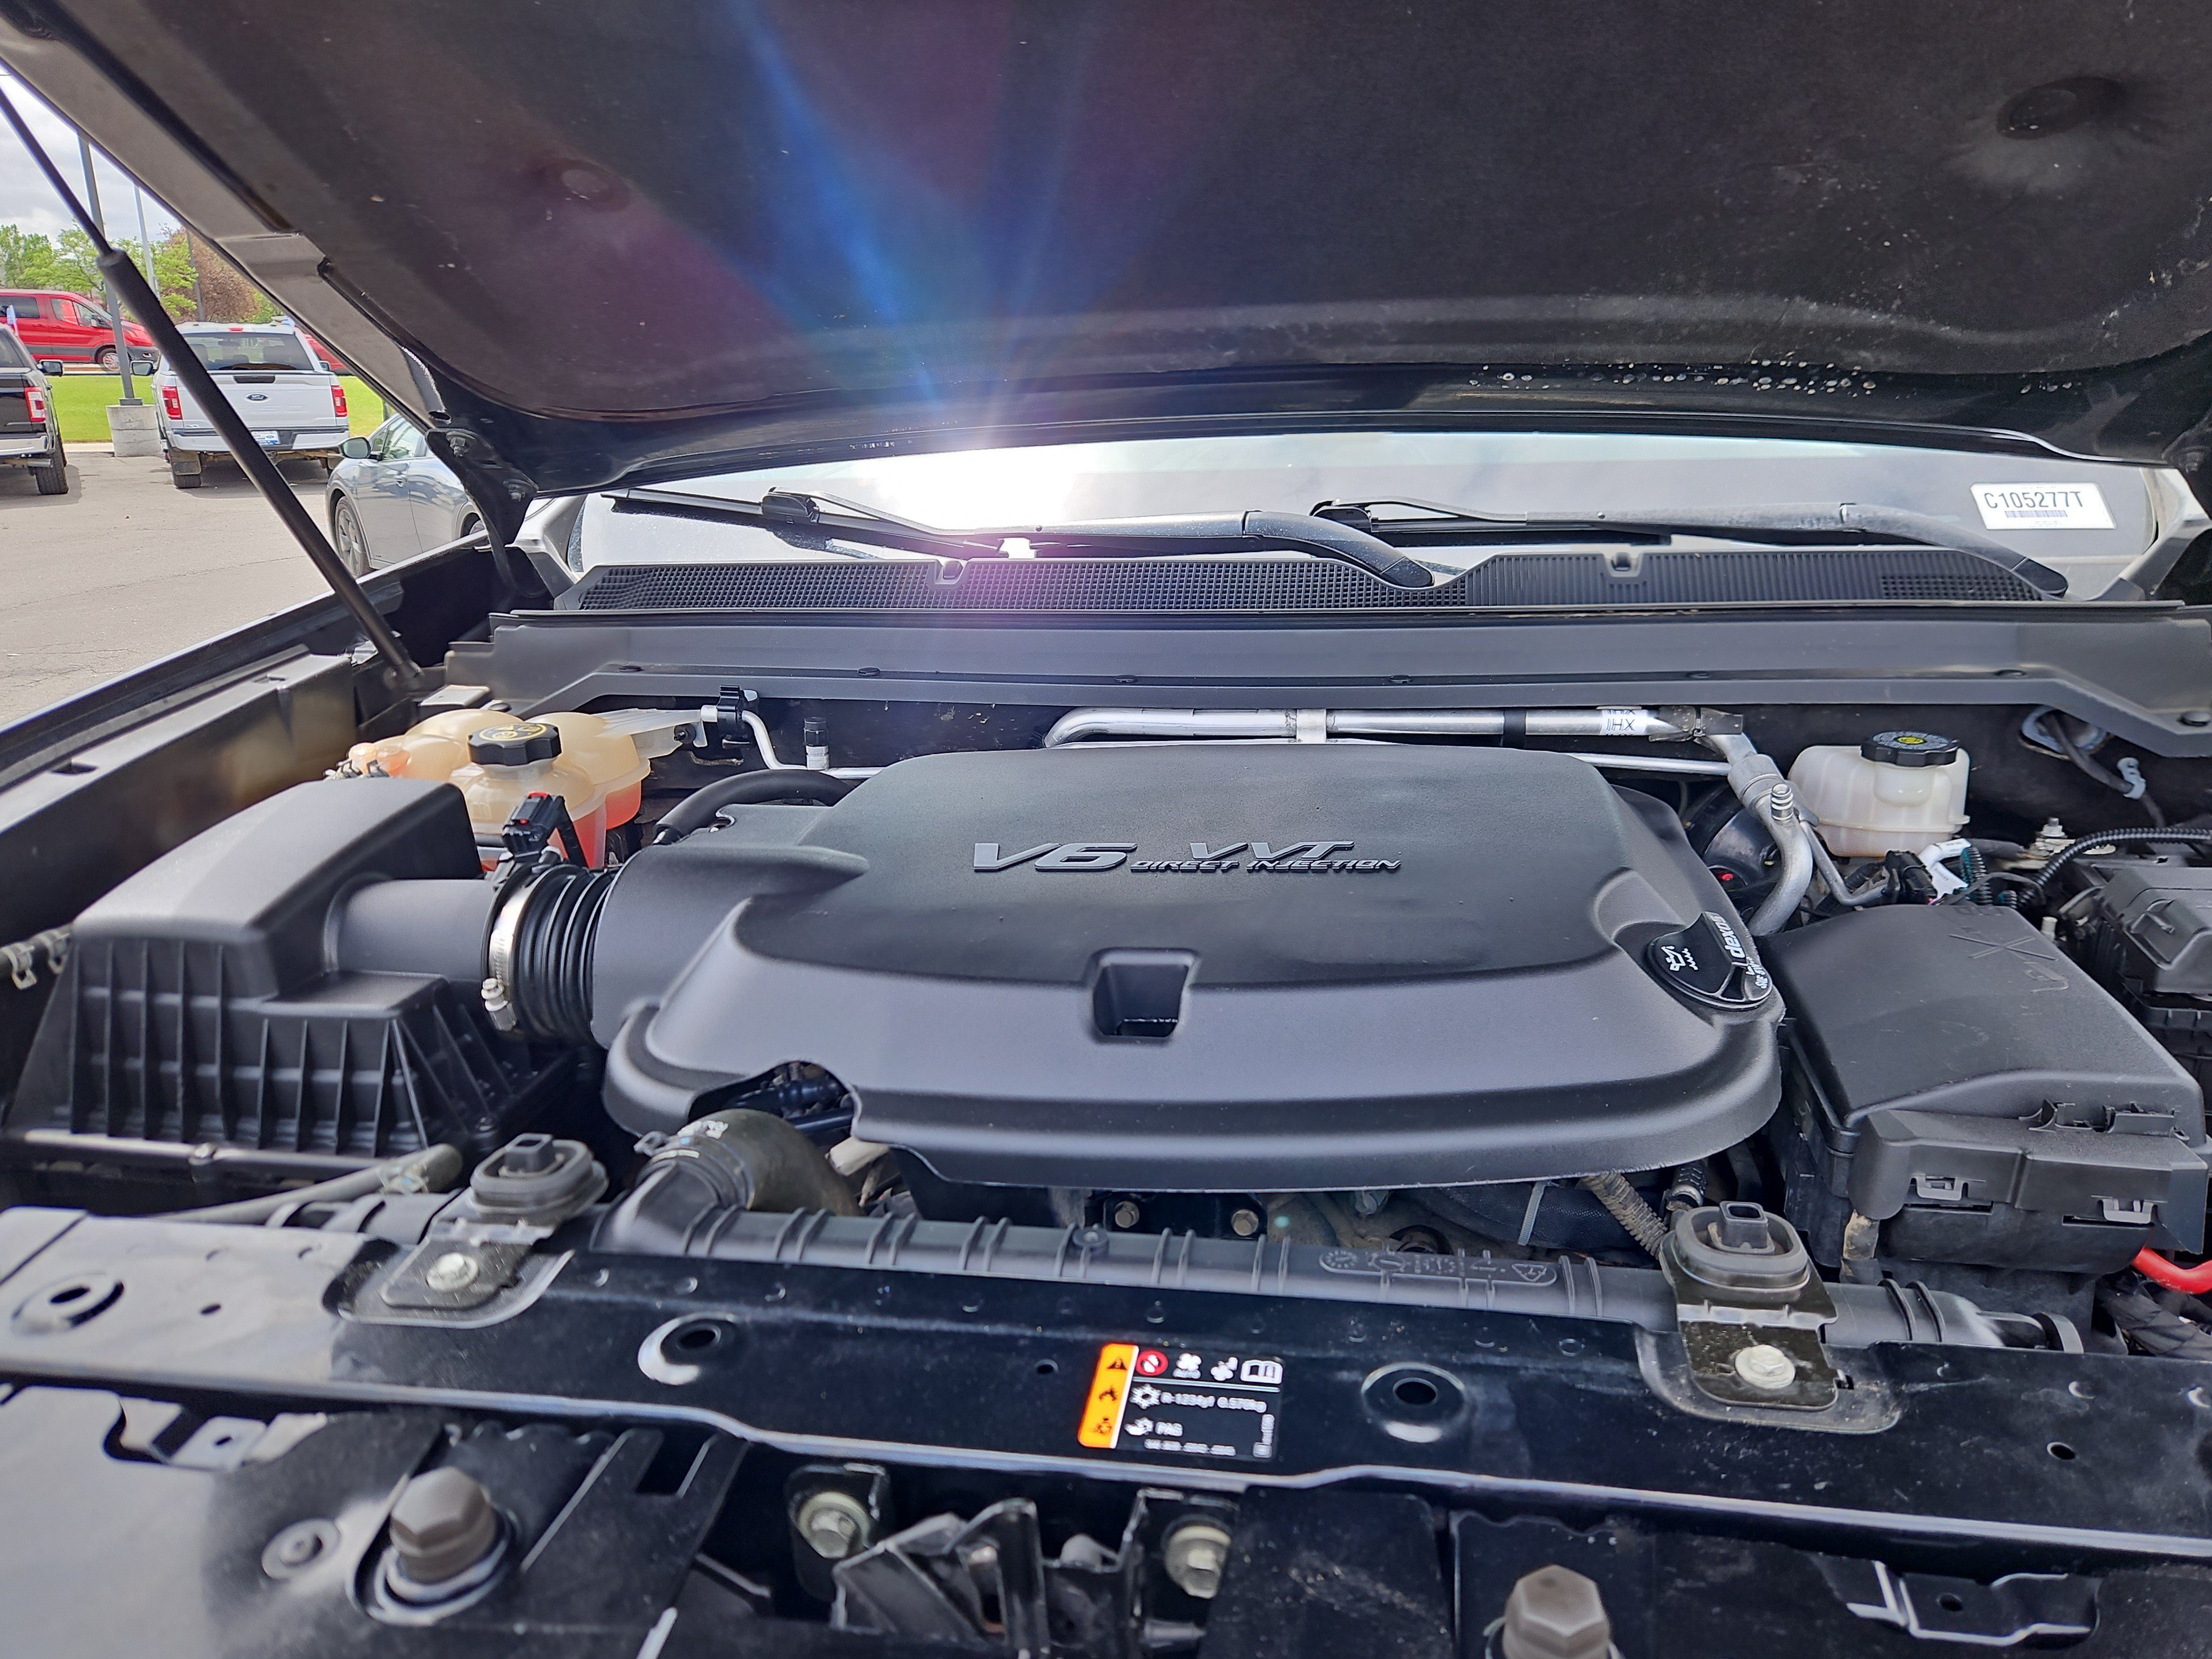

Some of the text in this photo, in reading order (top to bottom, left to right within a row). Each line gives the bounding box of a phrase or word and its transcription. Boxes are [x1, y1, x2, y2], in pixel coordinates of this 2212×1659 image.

[1984, 491, 2083, 509] C105277T
[974, 841, 1355, 871] V6 VVT
[1130, 860, 1401, 873] DIRECT INJECTION
